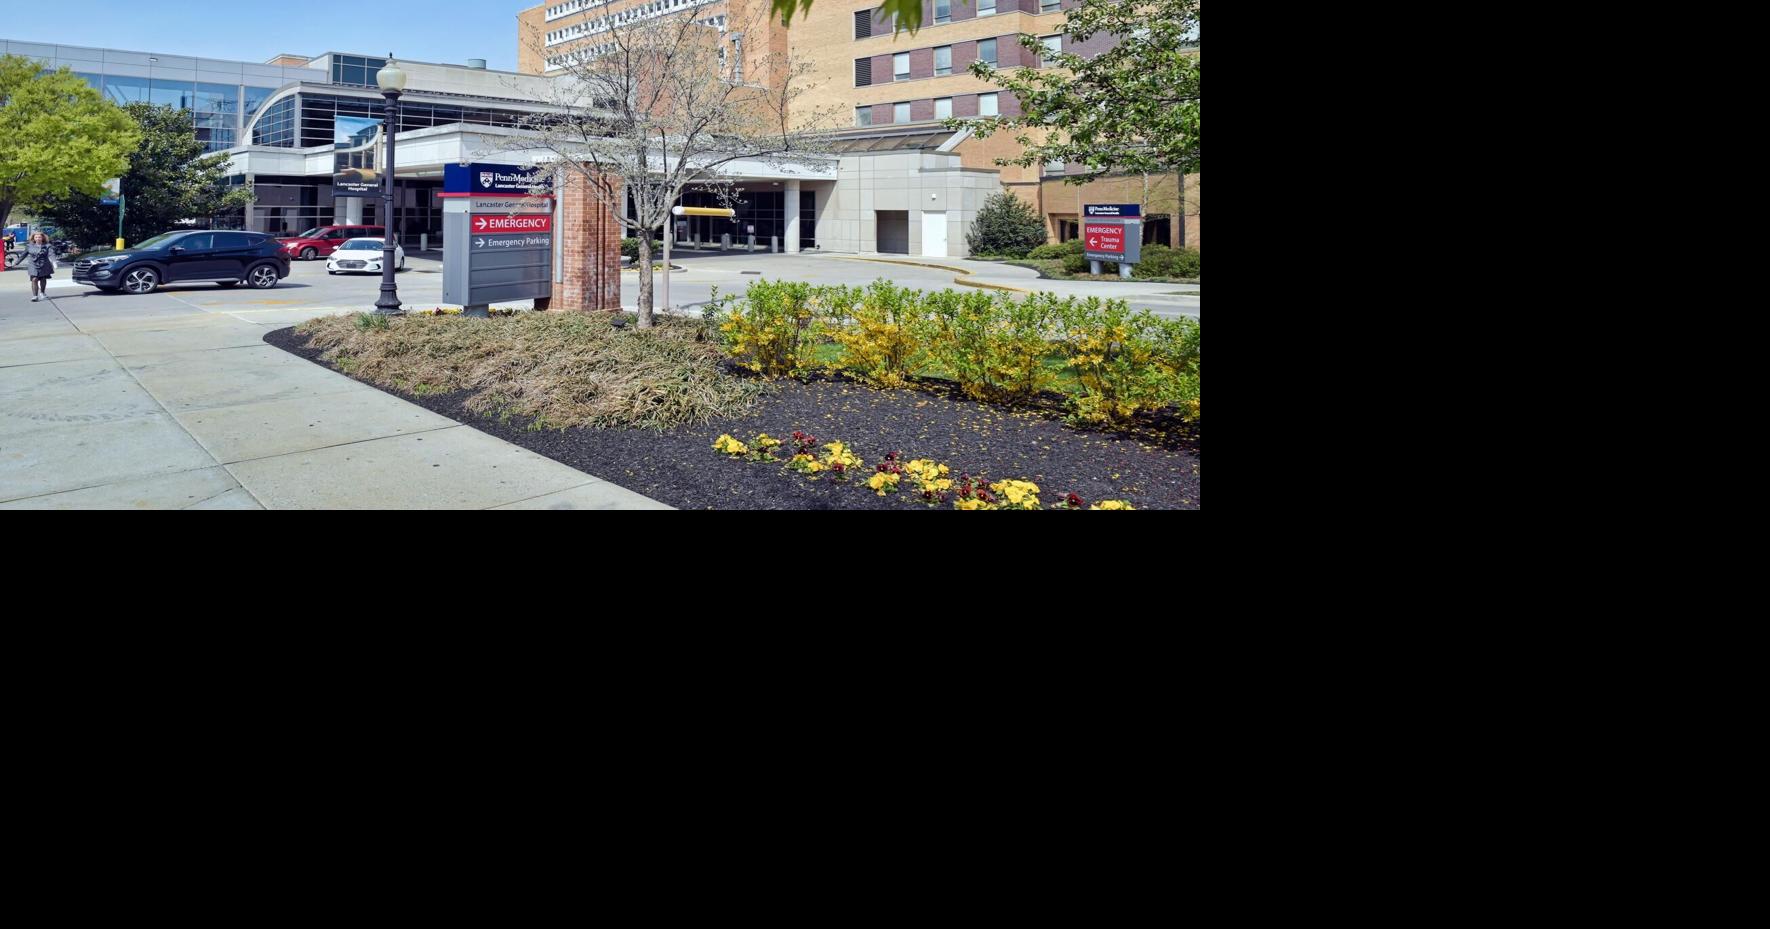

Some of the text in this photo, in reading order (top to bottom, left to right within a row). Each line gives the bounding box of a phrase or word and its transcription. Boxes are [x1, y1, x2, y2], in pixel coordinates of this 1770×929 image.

[495, 173, 511, 181] Penn
[489, 218, 546, 228] EMERGENCY
[488, 237, 550, 248] Emergency Parking
